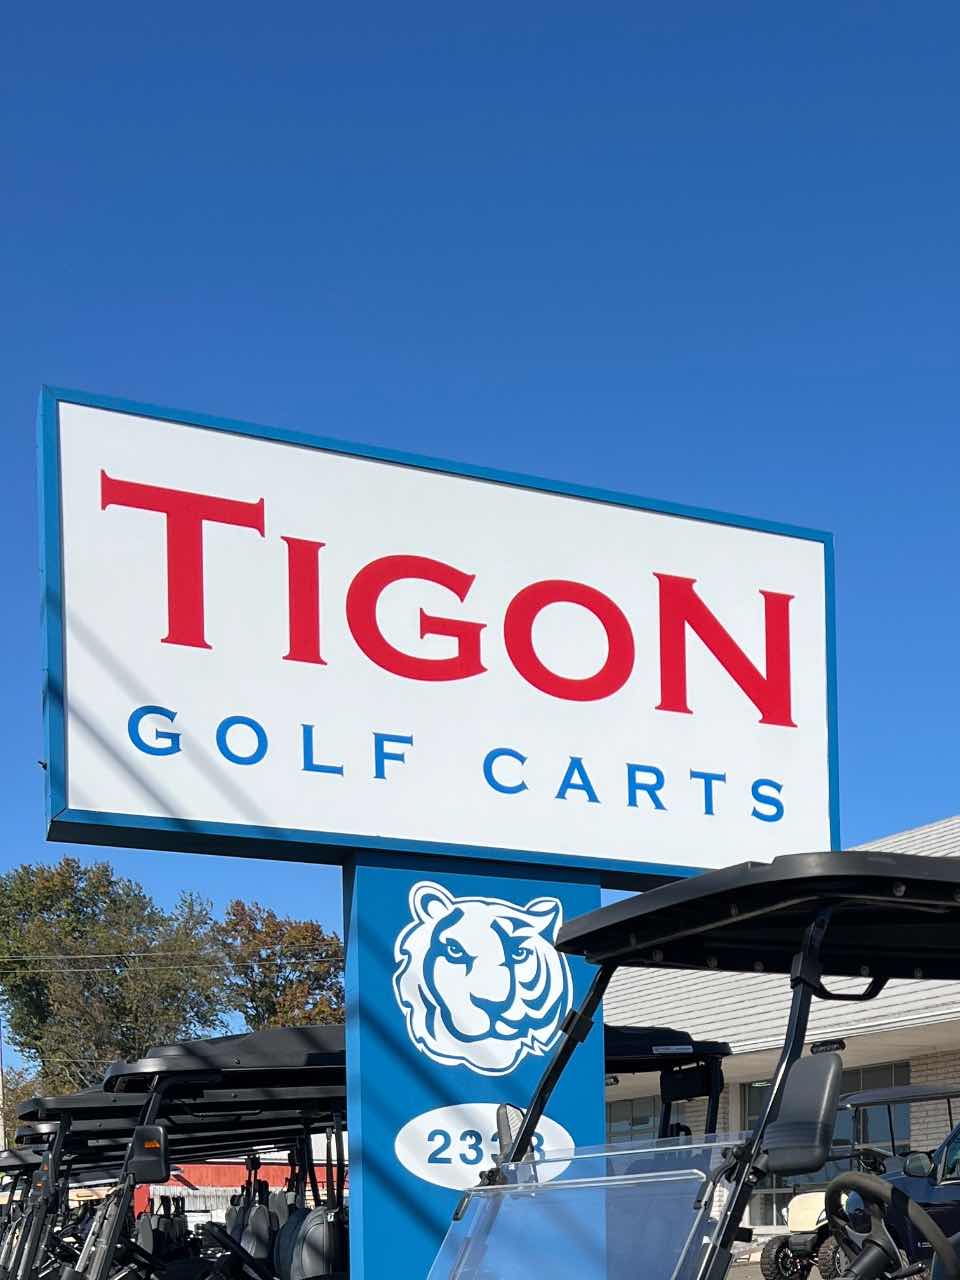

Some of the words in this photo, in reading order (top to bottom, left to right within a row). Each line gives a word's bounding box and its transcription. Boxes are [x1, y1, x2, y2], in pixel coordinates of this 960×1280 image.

[100, 469, 798, 727] TIGON
[127, 704, 414, 781] GOLF
[483, 747, 785, 823] CARTS
[427, 1129, 546, 1165] 23
